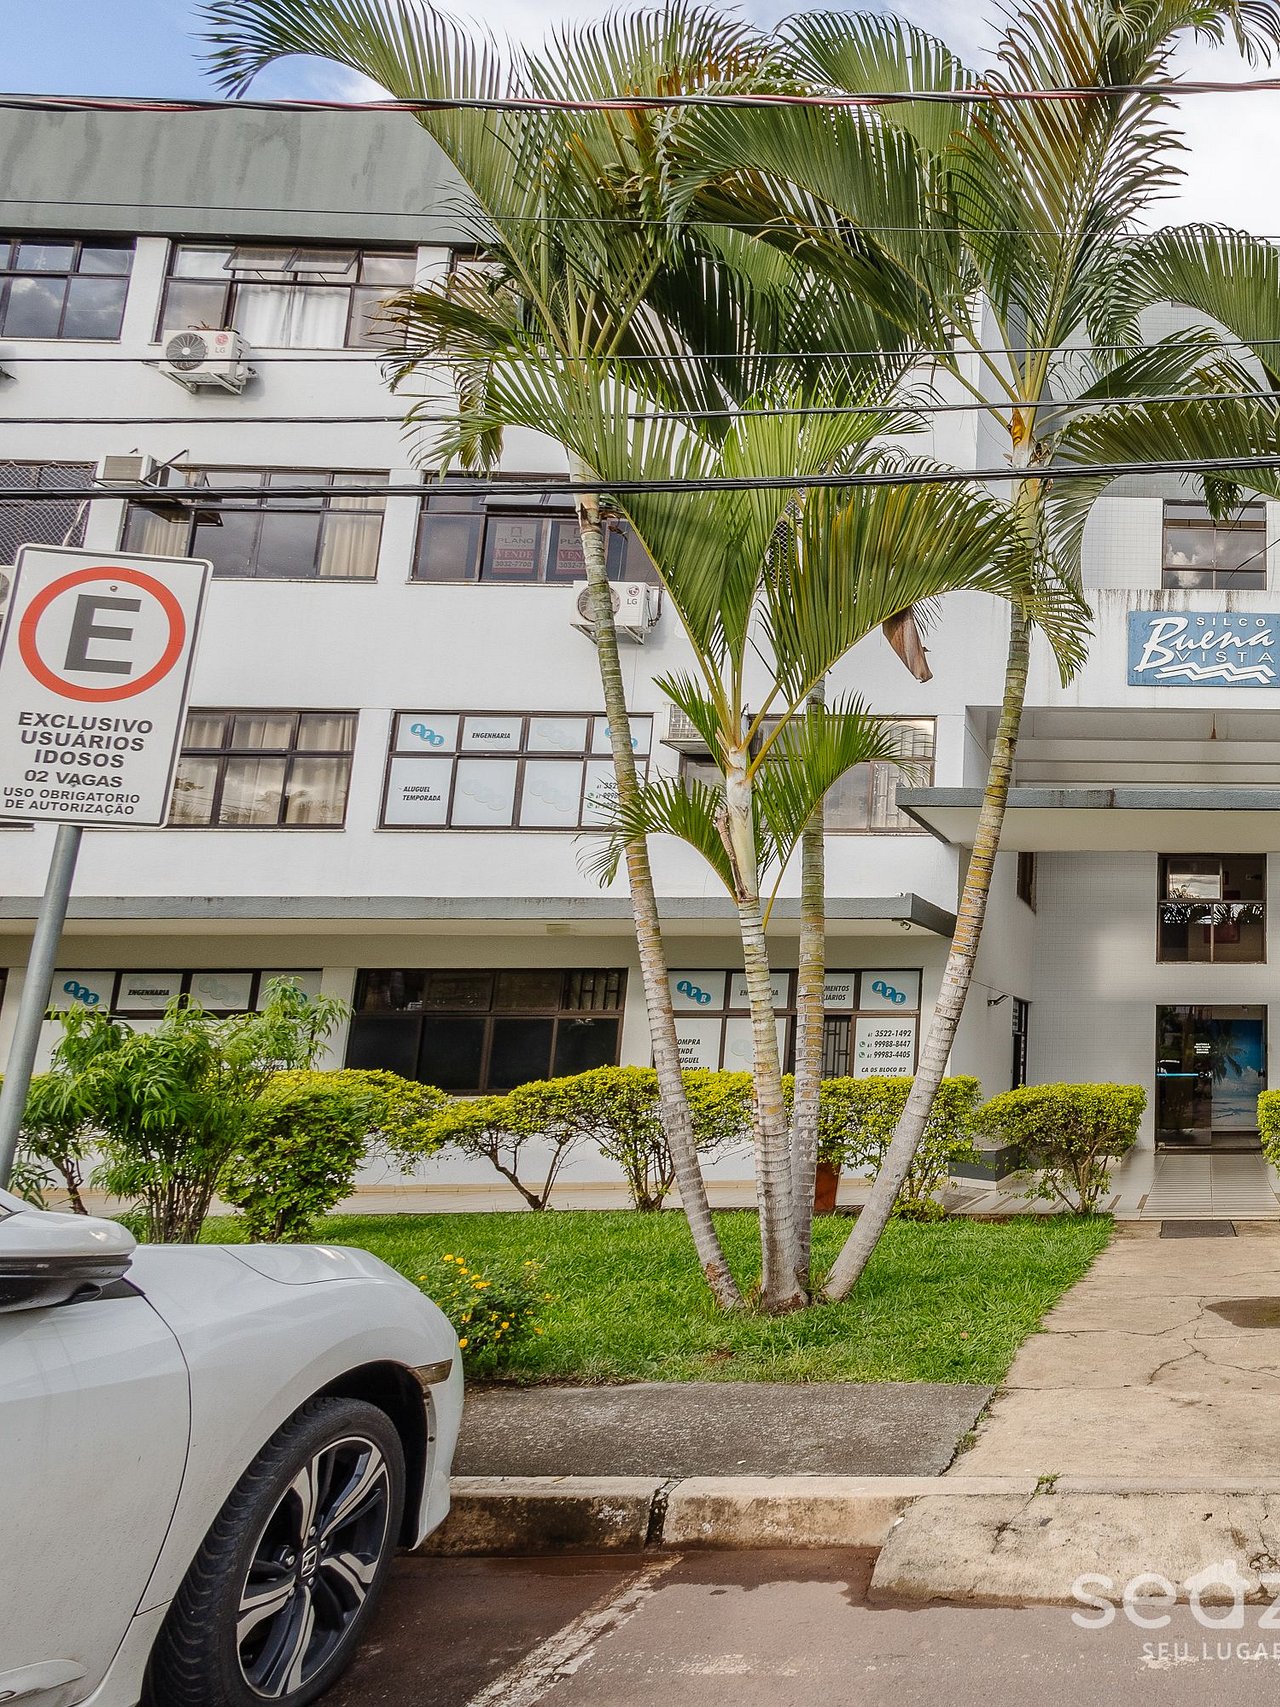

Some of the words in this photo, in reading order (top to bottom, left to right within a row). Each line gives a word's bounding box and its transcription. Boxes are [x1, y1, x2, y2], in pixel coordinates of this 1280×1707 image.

[495, 550, 533, 559] VENDE
[1196, 617, 1266, 627] SILCO
[63, 594, 142, 675] E
[1133, 616, 1275, 673] Buena
[1175, 651, 1275, 663] VISTA
[18, 711, 153, 734] EXCLUSIVO
[20, 730, 145, 752] USUÁRIOS
[34, 749, 125, 769] IDOSOS
[24, 769, 49, 783] 02
[56, 771, 123, 788] VAGAS
[3, 786, 34, 797] USO
[39, 789, 141, 803] OBRIGATORIO
[4, 798, 25, 809] DE
[28, 800, 135, 816] AUTORIZAÇÃO
[874, 1029, 912, 1037] 3522-1492
